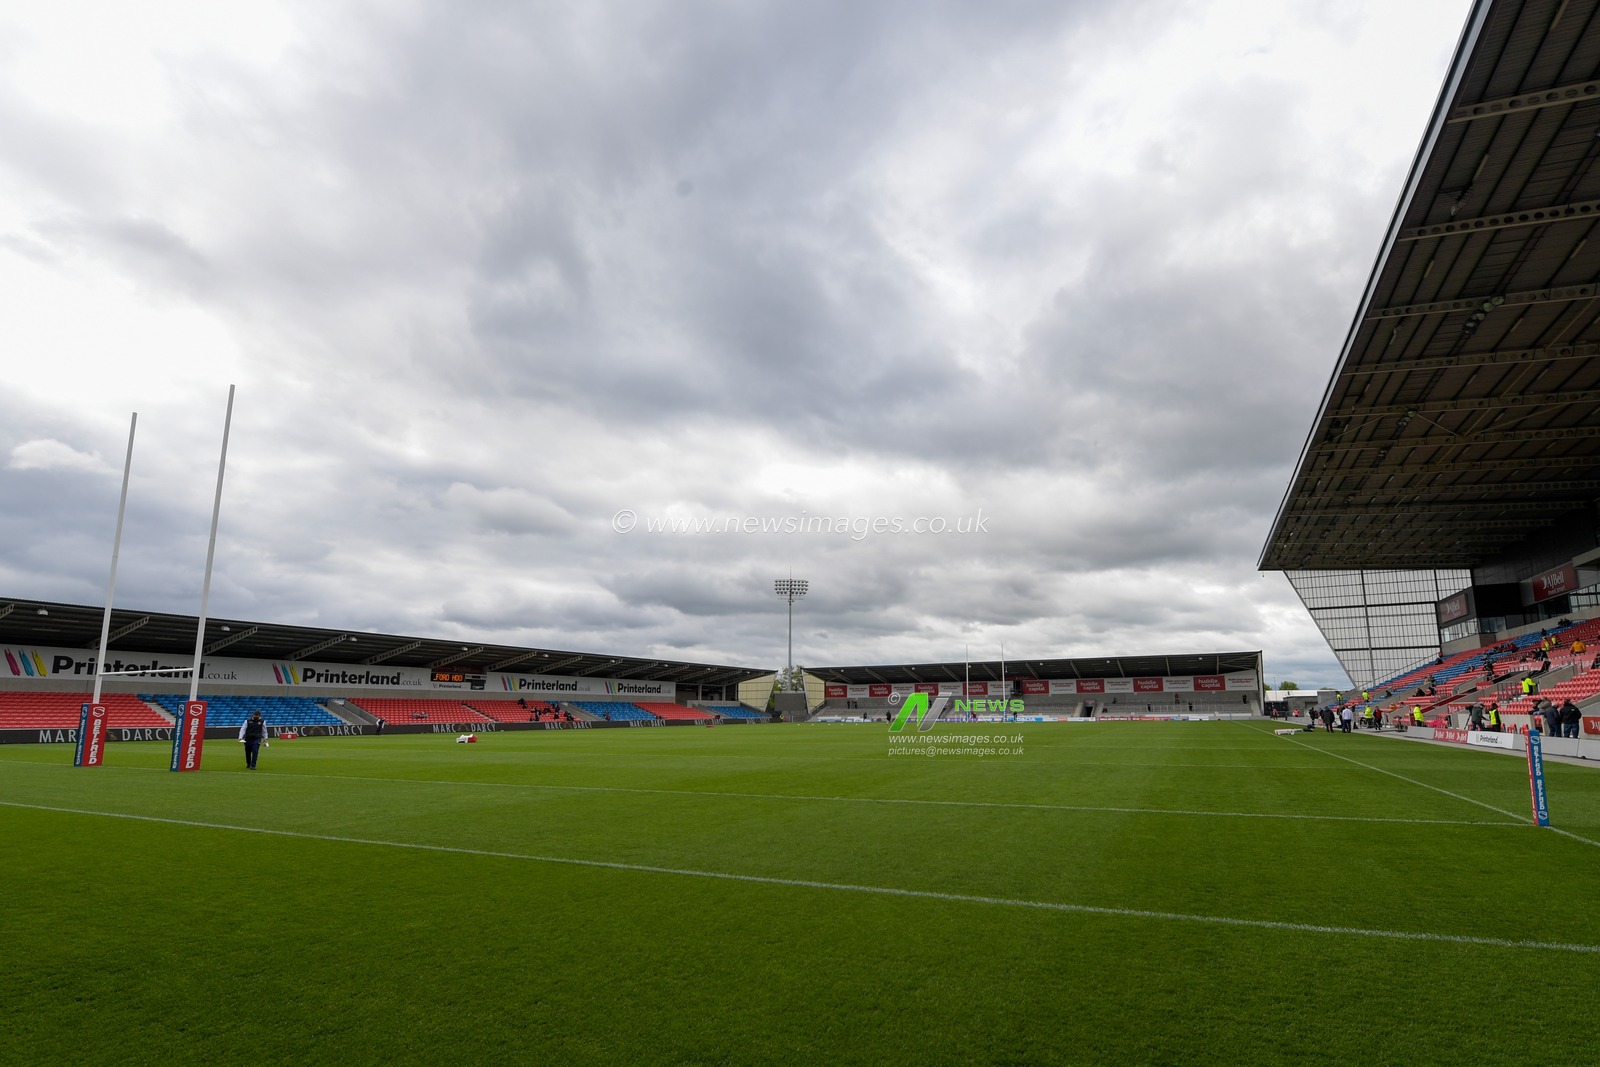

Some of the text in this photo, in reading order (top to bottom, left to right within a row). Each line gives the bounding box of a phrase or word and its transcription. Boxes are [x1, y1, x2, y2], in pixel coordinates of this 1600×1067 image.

[274, 725, 363, 737] MARC DARCY
[432, 724, 457, 733] MARC
[544, 721, 592, 730] MARC DARCY
[39, 728, 173, 743] MAR DARCY
[88, 718, 102, 765] BETFRED
[185, 718, 200, 769] BETFRED
